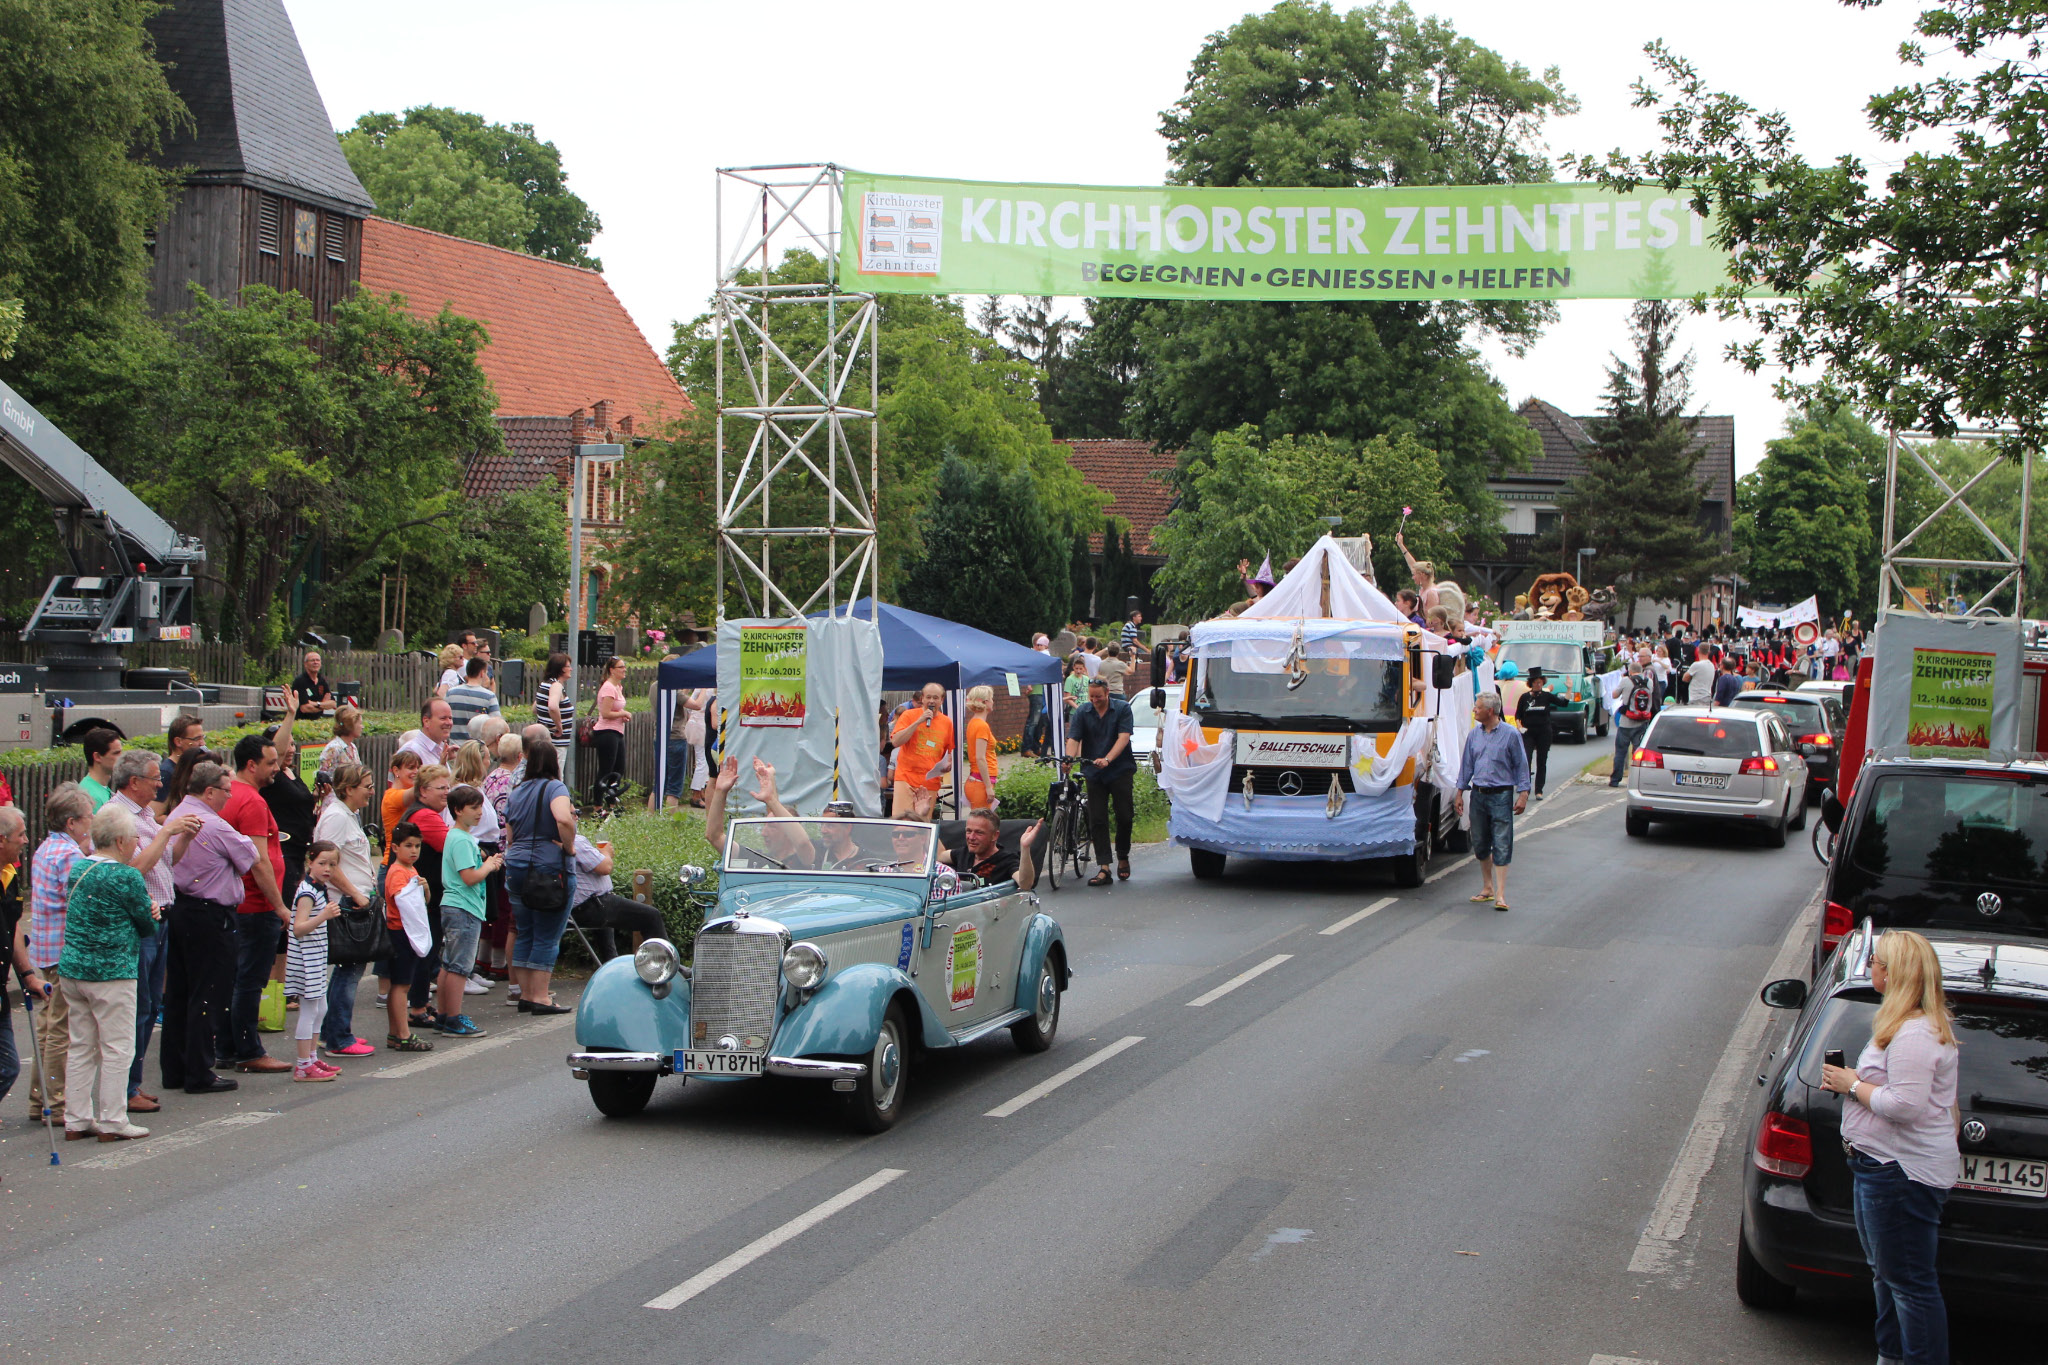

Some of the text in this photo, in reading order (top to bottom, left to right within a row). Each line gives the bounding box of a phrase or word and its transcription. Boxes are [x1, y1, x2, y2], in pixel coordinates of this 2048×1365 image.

[867, 194, 941, 209] Kirchhorster
[960, 197, 1702, 255] KIRCHHORSTER ZEHNTFEST
[865, 259, 937, 271] Zehntfest
[1081, 262, 1570, 289] BEGEGNEN GENIESSEN HELFEN
[3, 398, 35, 437] GmbH
[743, 632, 804, 641] 9. KIRCHHORSTER
[743, 641, 804, 653] ZEHNTFEST
[1917, 654, 1992, 668] 9. KIRCHHORSTER
[1916, 665, 1992, 682] ZEHNTFEST
[1258, 741, 1345, 754] BALLETTSCHULE
[1681, 775, 1724, 786] H LA 9182
[684, 1053, 695, 1070] H
[1958, 1157, 2045, 1188] W 1145
